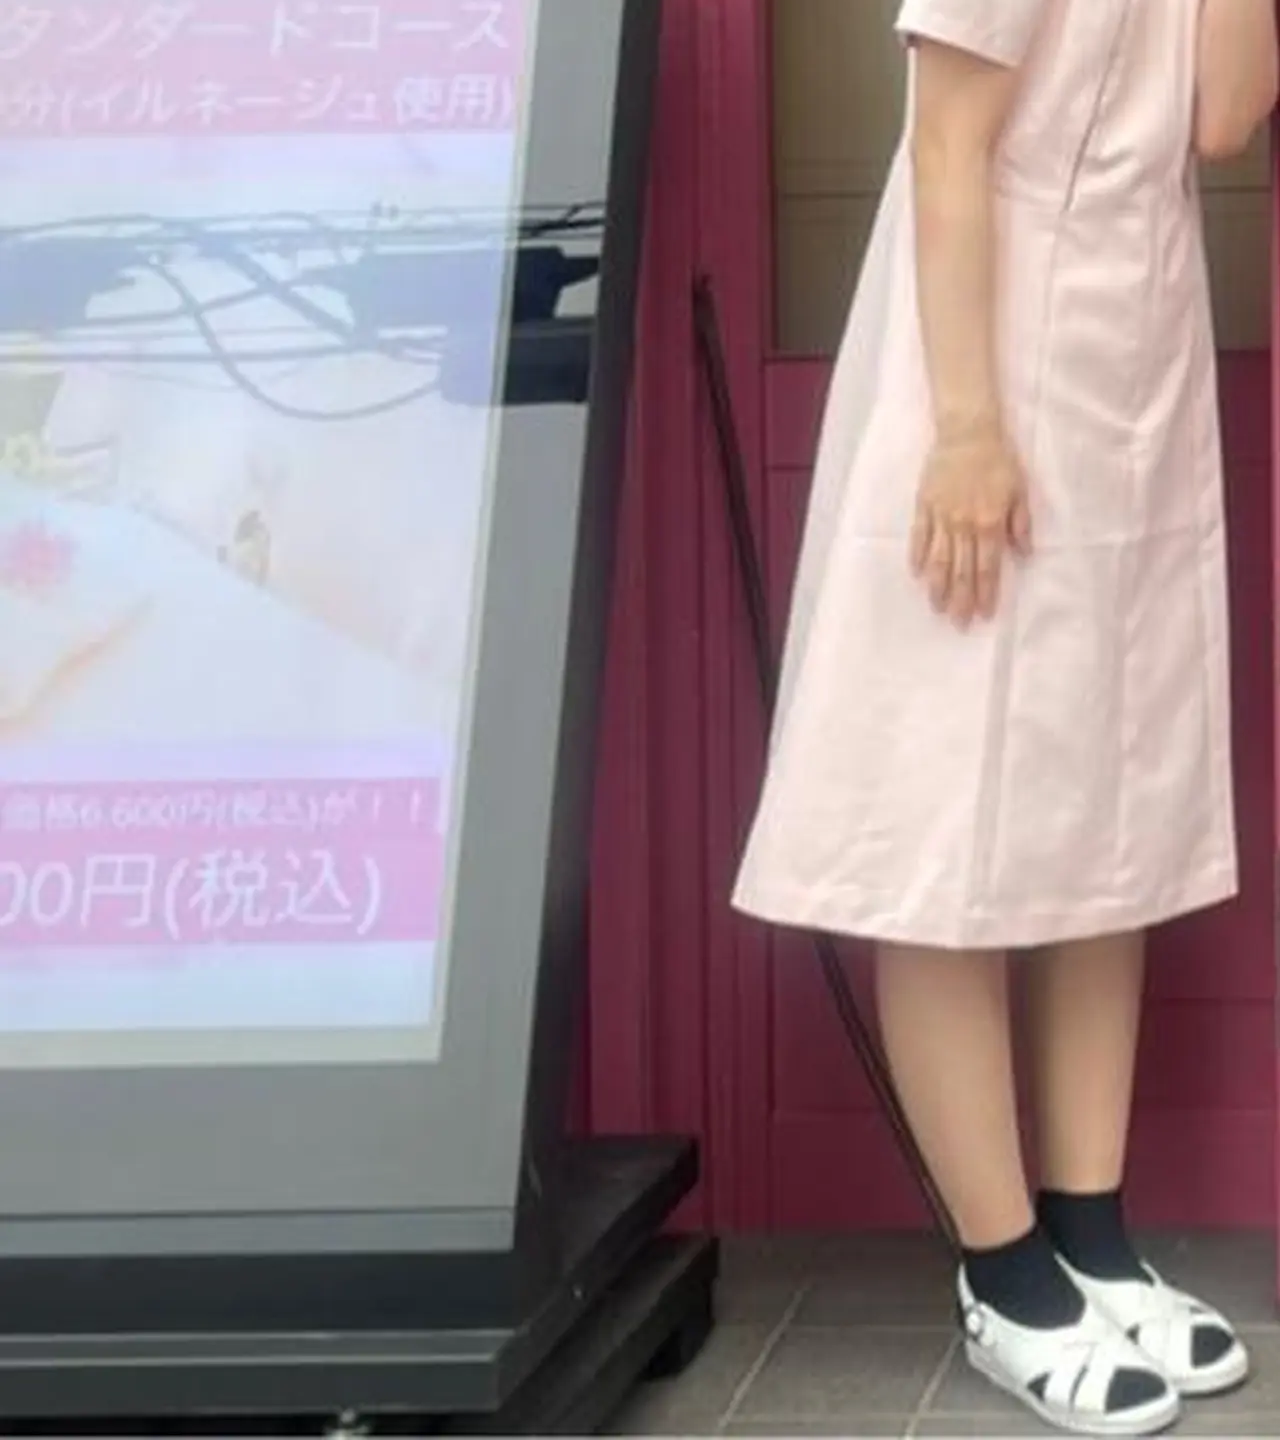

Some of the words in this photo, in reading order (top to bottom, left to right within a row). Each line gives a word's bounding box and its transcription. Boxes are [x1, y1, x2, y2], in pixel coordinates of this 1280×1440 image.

[0, 0, 508, 60] タンダードコース
